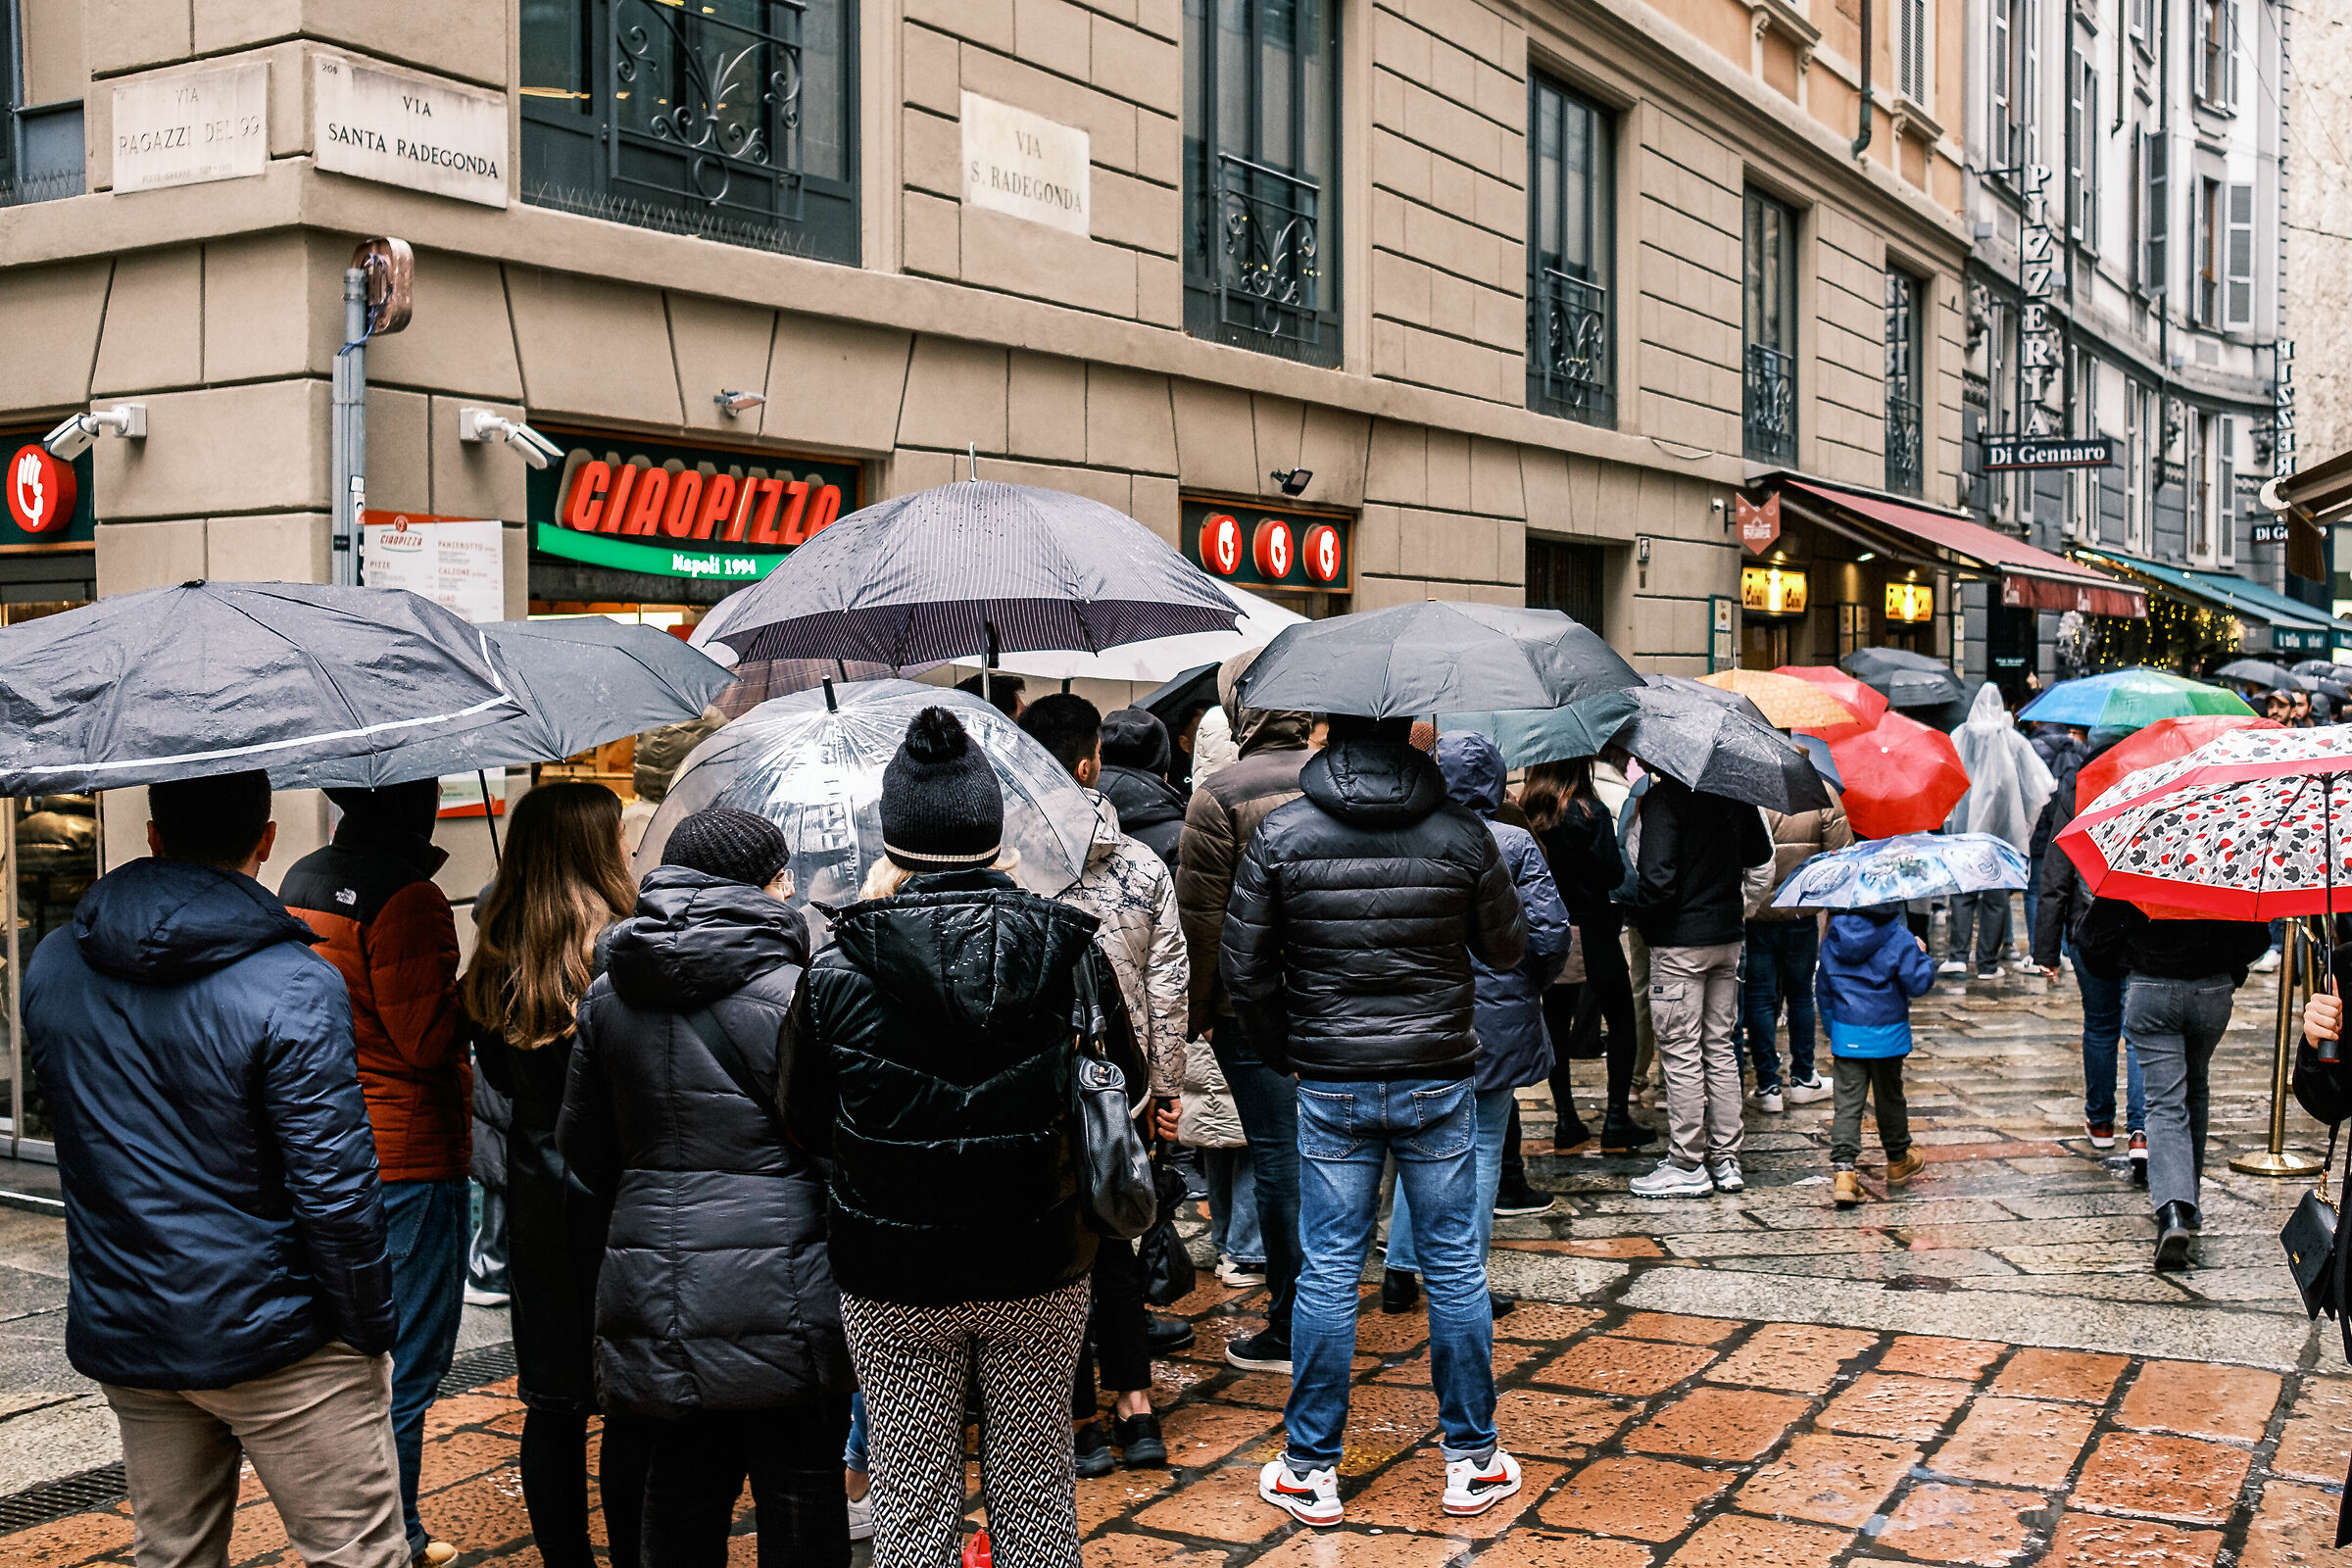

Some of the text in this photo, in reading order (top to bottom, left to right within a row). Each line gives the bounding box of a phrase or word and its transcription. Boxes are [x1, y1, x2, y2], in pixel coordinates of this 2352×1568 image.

[175, 87, 199, 103] VIA
[402, 96, 432, 118] VIA
[119, 124, 192, 157] RAGAZZI
[328, 122, 500, 180] SANTA RADEGONDA
[1015, 129, 1042, 159] VIA
[991, 166, 1082, 213] RADEGONDA
[2022, 163, 2052, 438] PIZZERIA
[1989, 445, 2106, 466] Di Gennaro
[672, 553, 757, 577] Napoli 1994
